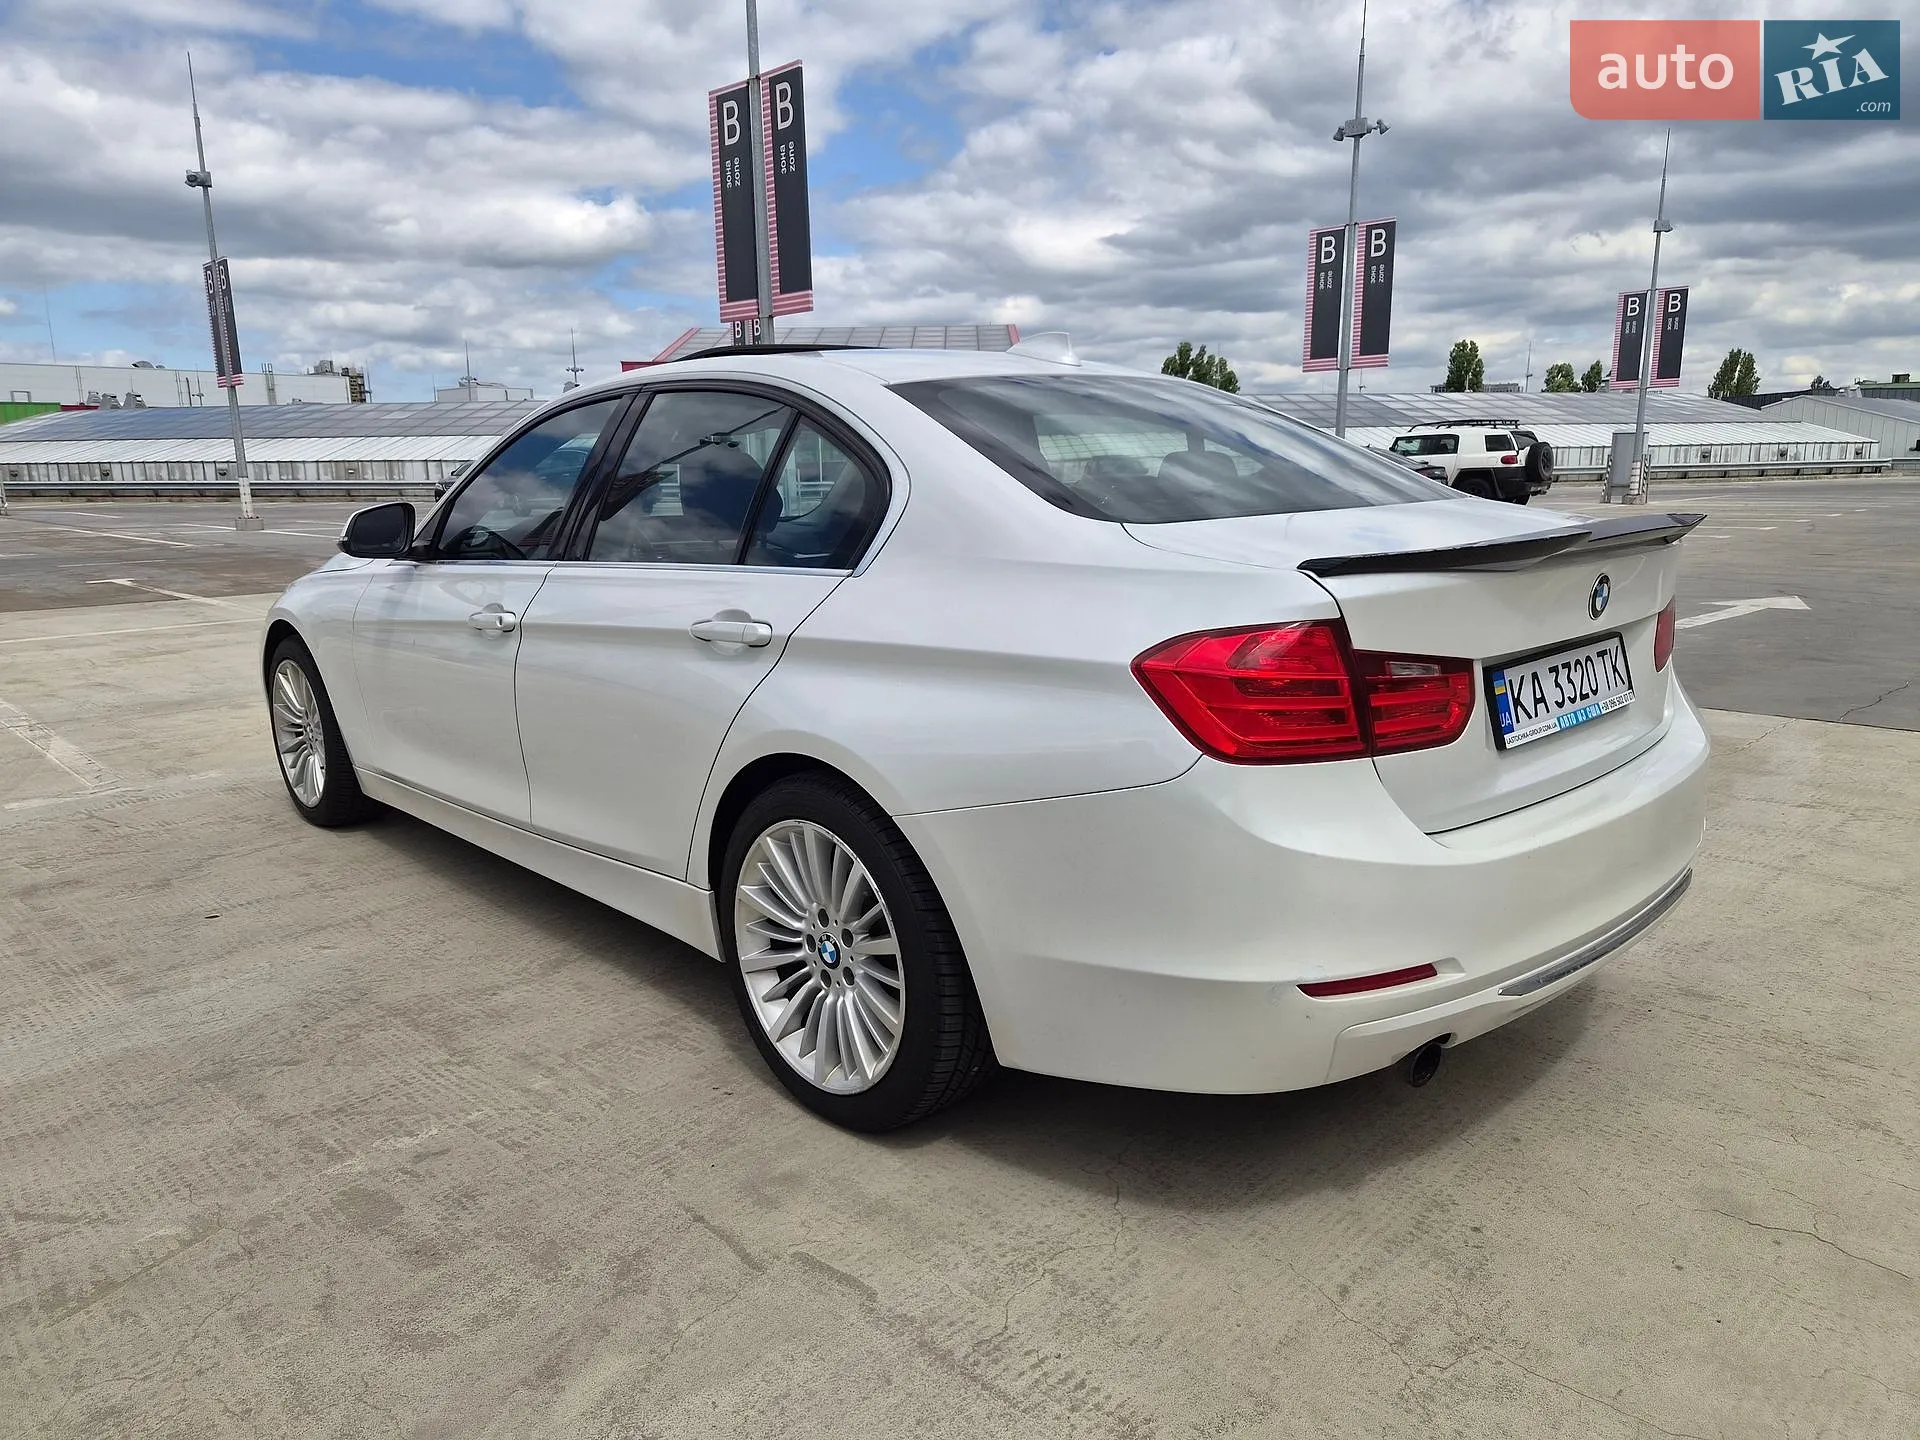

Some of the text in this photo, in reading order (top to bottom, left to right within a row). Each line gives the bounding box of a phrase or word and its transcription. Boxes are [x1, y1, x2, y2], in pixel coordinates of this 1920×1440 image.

[775, 81, 794, 131] B
[722, 100, 741, 147] B
[1320, 235, 1336, 264] B
[1370, 228, 1387, 258] B
[1626, 297, 1640, 317] B
[1667, 293, 1681, 313] B
[734, 321, 742, 339] B
[753, 318, 761, 336] B
[1508, 645, 1626, 724] KA 3320 TK
[1500, 712, 1513, 728] UA
